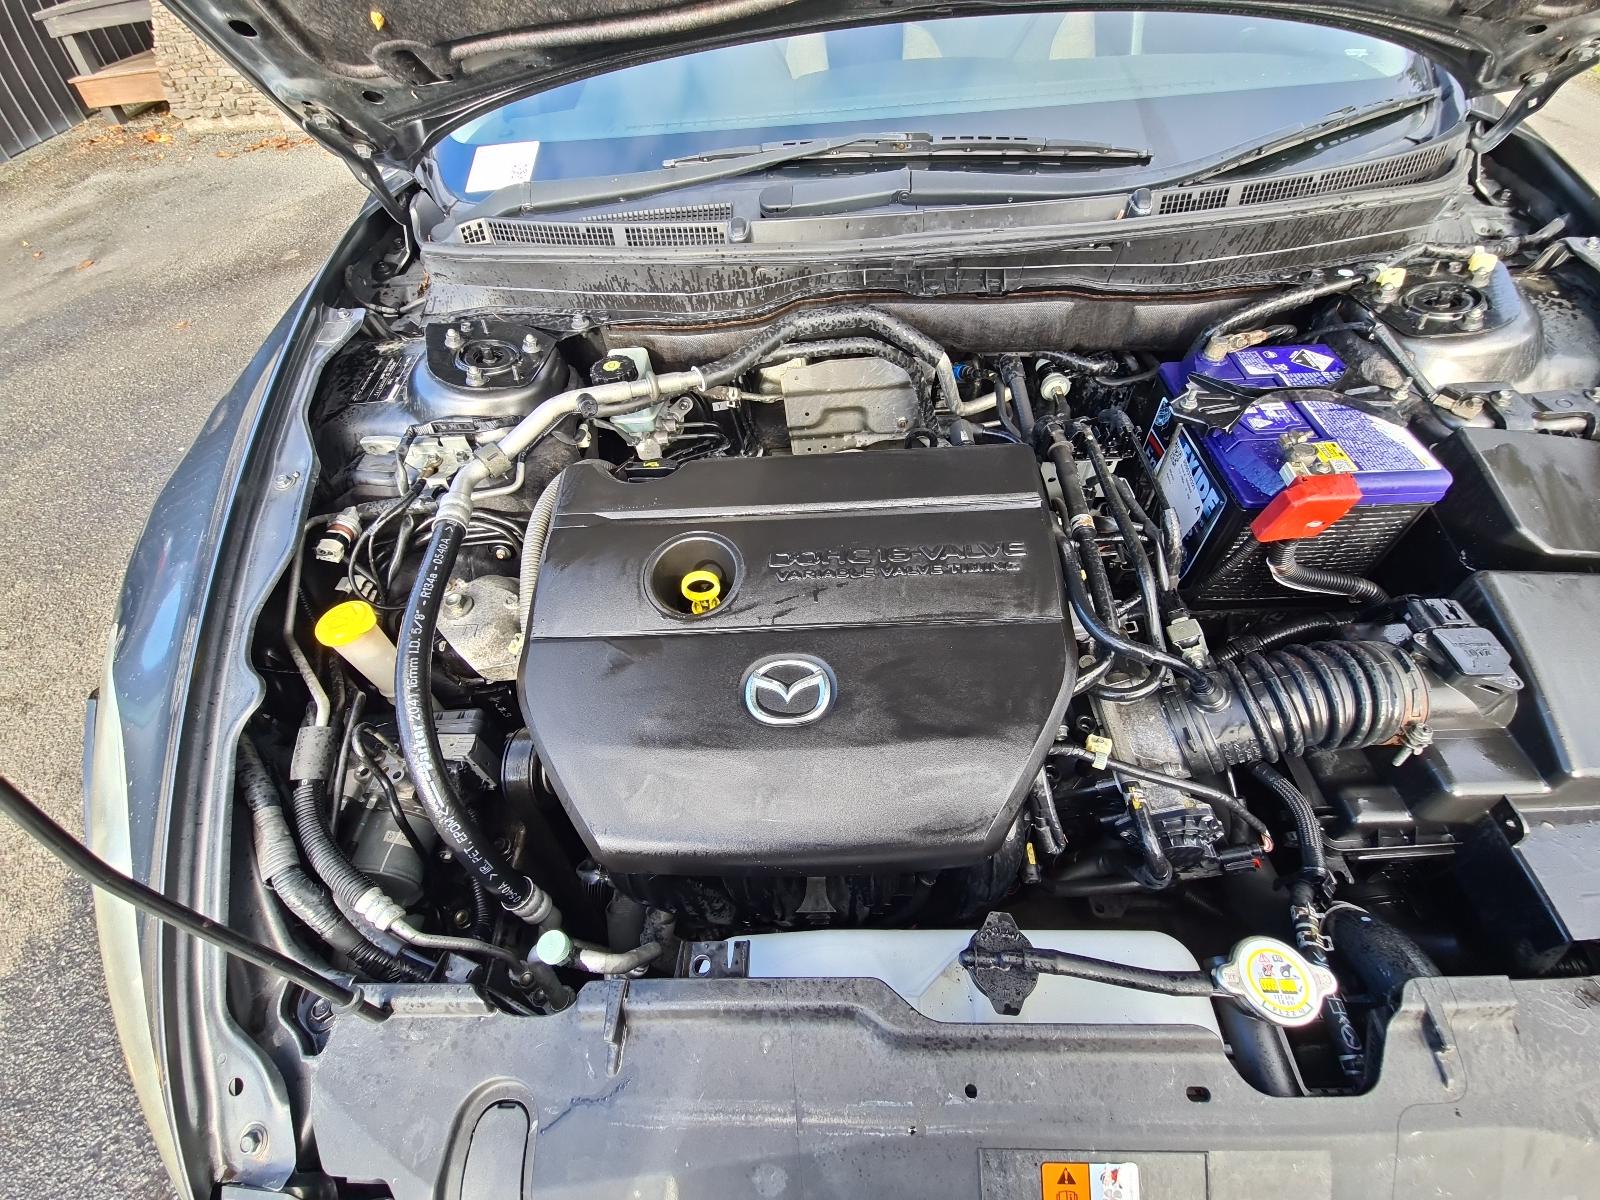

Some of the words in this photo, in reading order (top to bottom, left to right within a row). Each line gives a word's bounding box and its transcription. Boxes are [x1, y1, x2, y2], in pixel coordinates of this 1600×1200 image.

[768, 548, 871, 568] DOHC
[775, 566, 876, 583] VARIABLE
[880, 563, 944, 578] VALVE
[406, 657, 419, 690] 16mm
[420, 573, 438, 599] R134a
[432, 538, 452, 565] 0540A
